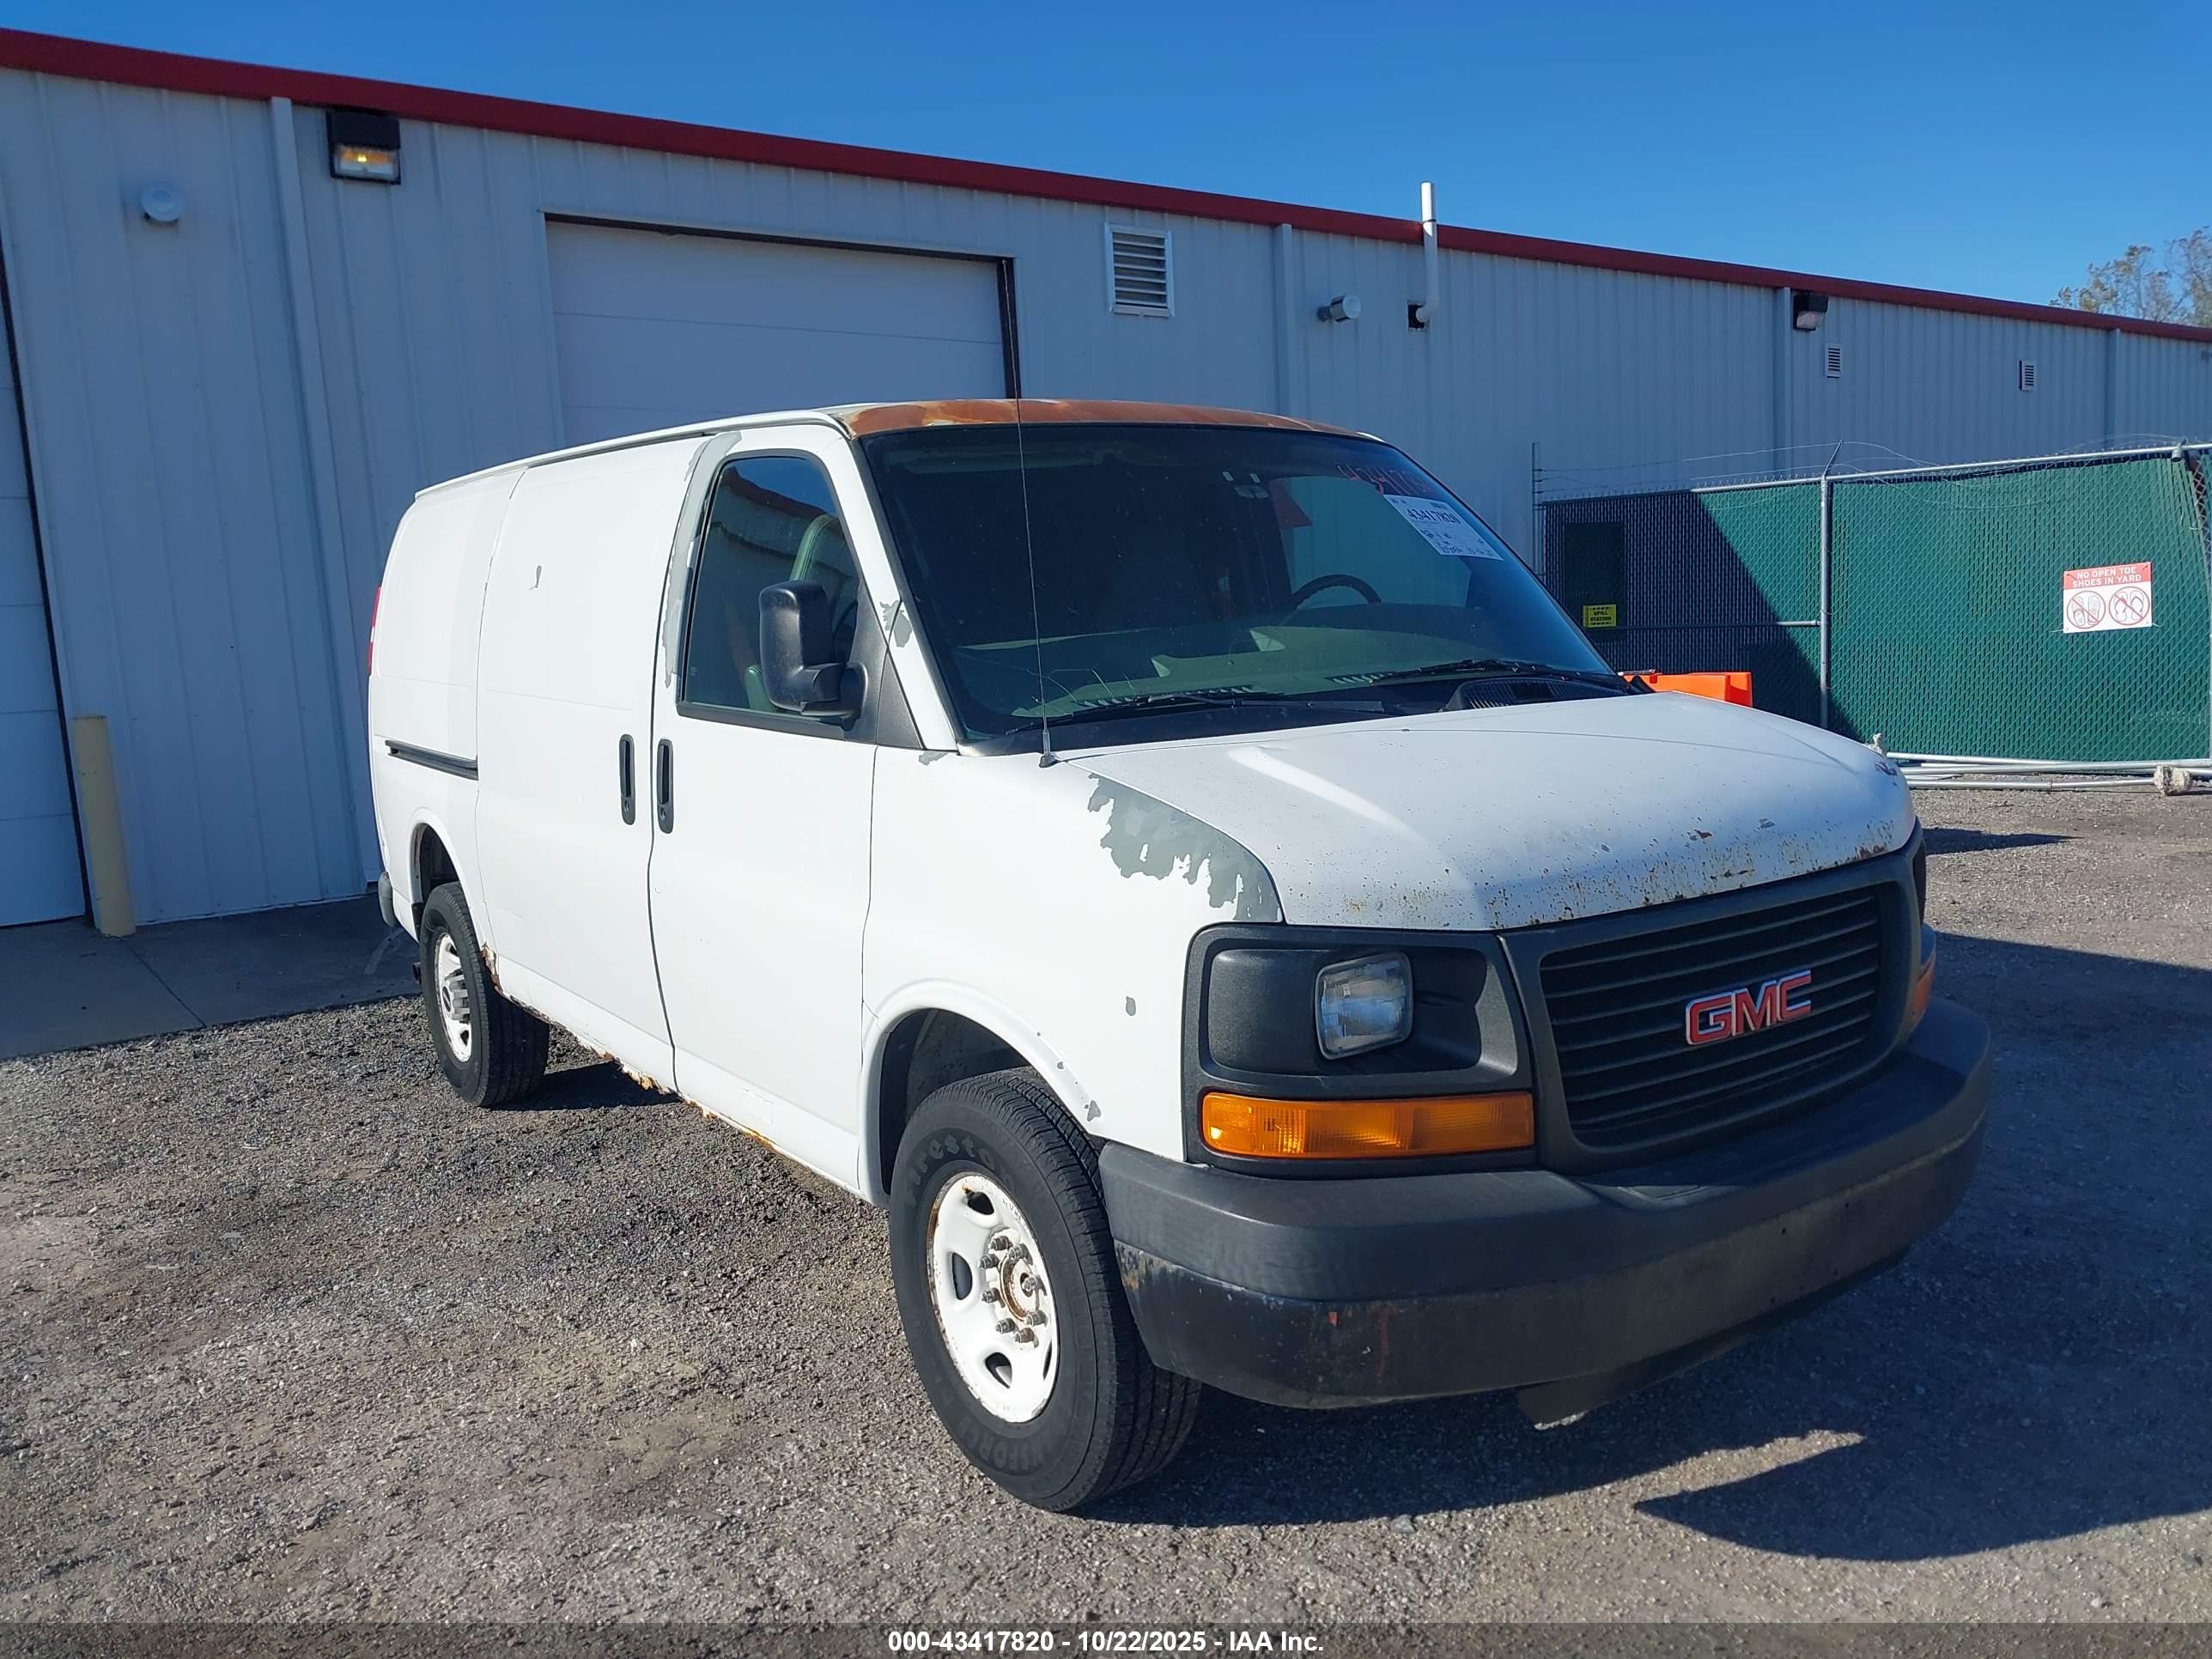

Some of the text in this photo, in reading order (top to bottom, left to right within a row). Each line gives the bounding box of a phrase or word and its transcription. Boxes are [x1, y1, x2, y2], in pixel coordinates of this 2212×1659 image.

[2076, 566, 2137, 580] NO OPEN TOE
[2072, 574, 2142, 588] SHOES IN YARD
[1685, 969, 1812, 1045] GMC
